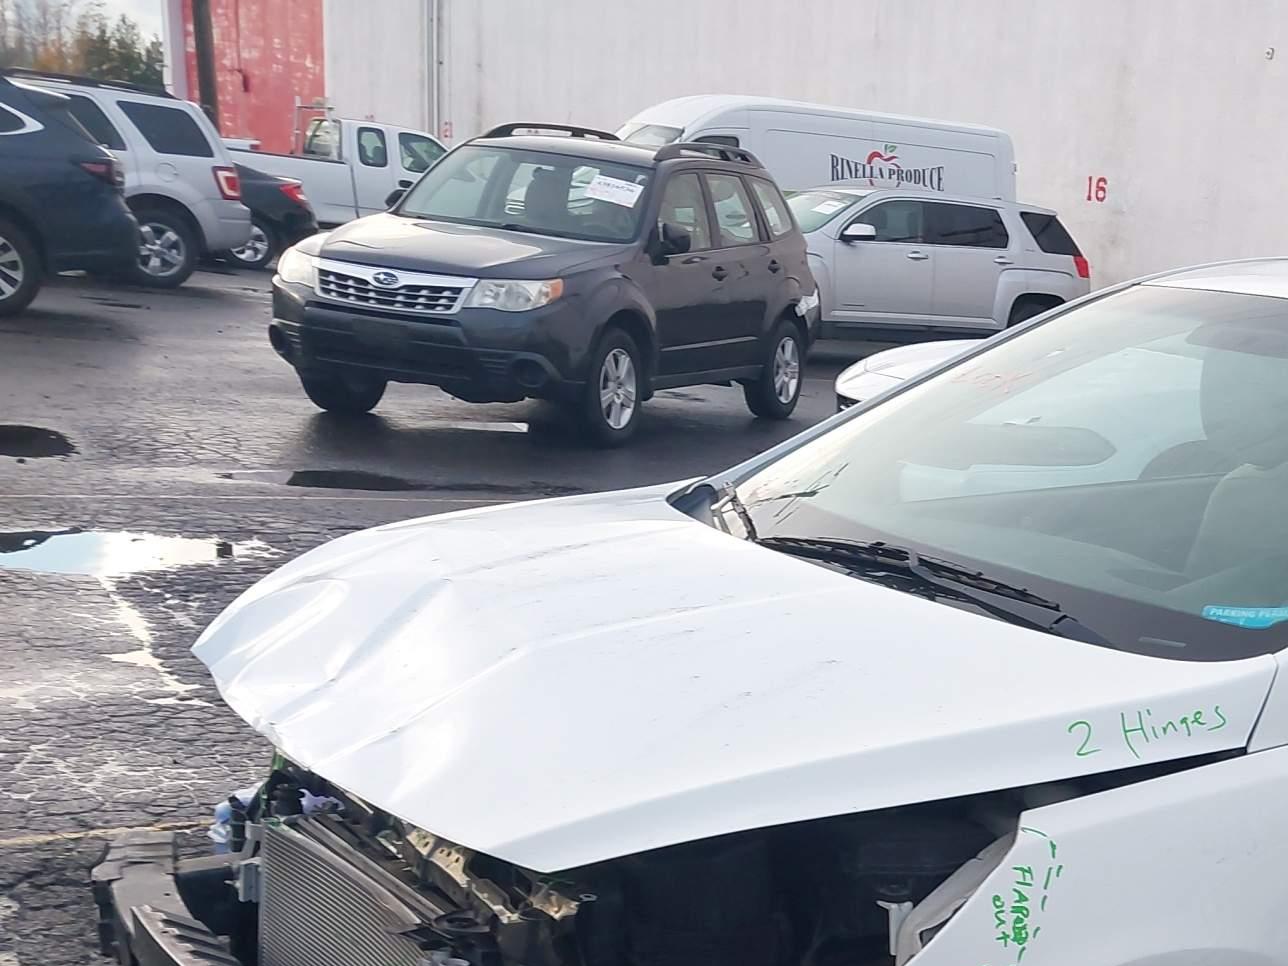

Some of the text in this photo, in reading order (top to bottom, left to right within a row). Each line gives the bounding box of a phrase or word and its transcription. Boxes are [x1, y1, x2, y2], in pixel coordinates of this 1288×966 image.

[830, 153, 945, 192] RINELLA PRODUCE
[1086, 175, 1108, 203] 16
[1068, 705, 1227, 759] 2 Hinges
